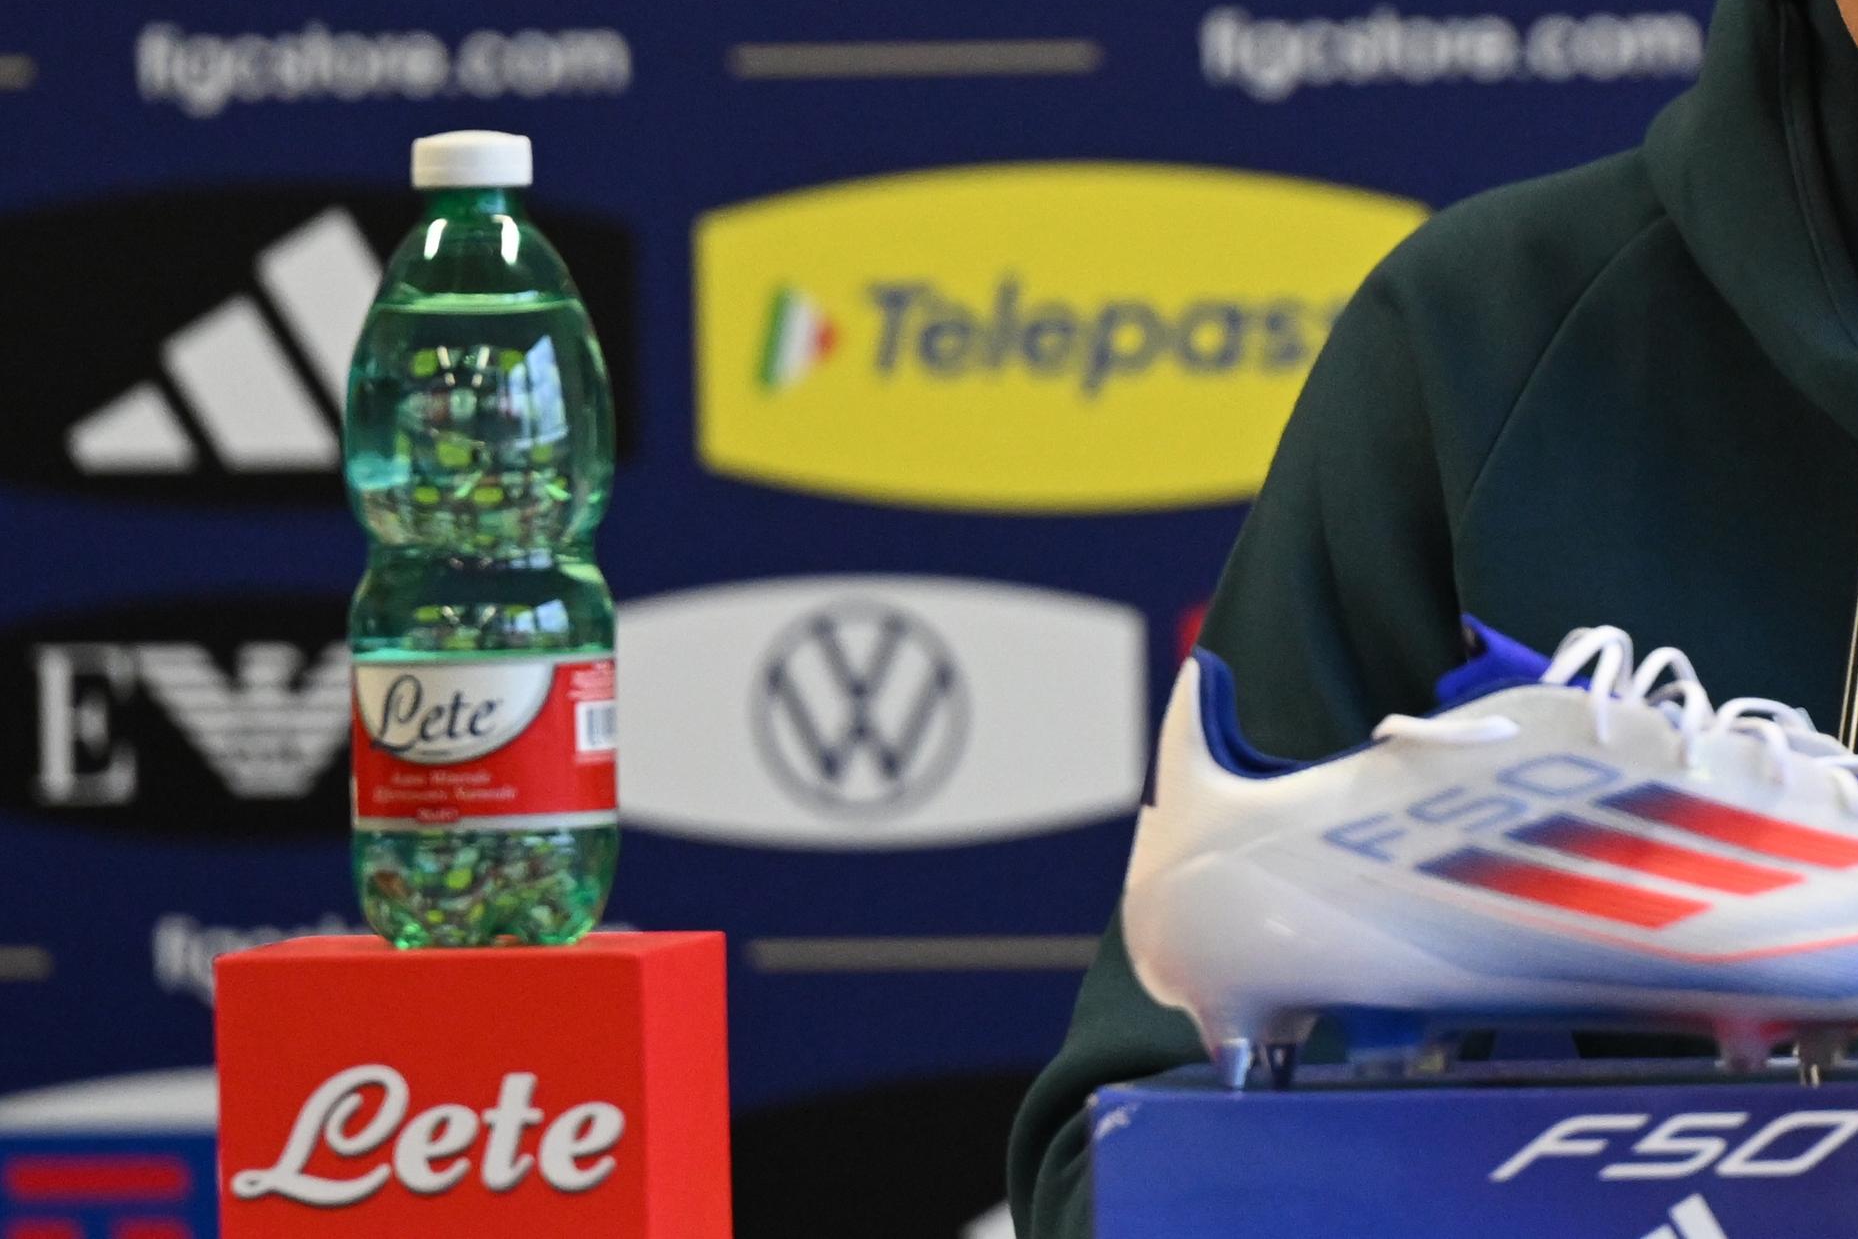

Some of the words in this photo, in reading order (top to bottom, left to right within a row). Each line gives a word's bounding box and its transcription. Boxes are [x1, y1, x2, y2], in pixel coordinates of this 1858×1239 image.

[137, 24, 631, 115] figcstore.com
[1201, 8, 1704, 99] figcstore.com
[864, 273, 1348, 399] Telepas
[369, 673, 503, 754] Lete
[229, 1063, 626, 1207] Lete
